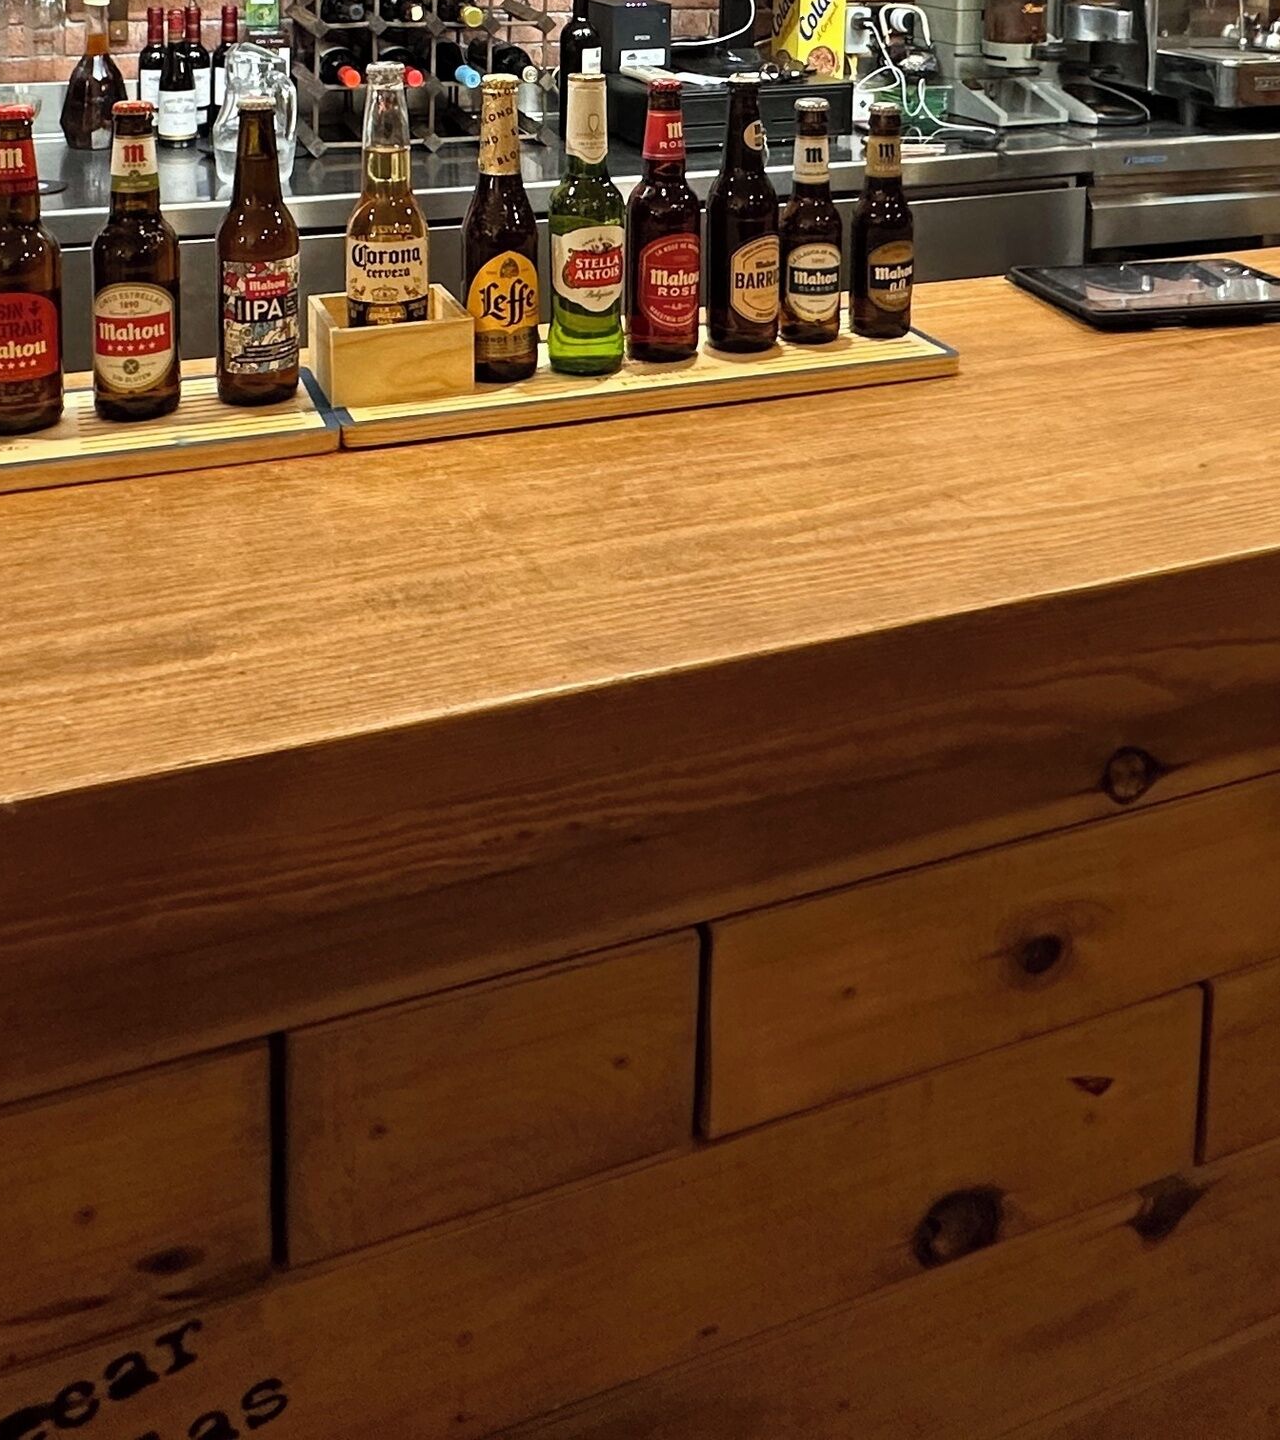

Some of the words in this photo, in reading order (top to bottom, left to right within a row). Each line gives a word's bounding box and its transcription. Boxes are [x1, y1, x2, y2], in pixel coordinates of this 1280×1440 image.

[352, 244, 422, 271] Corona
[575, 255, 620, 269] STELLA
[574, 266, 620, 280] ARTOIS
[245, 298, 283, 321] IPA
[479, 278, 535, 328] Leffe
[98, 322, 166, 341] Mahou
